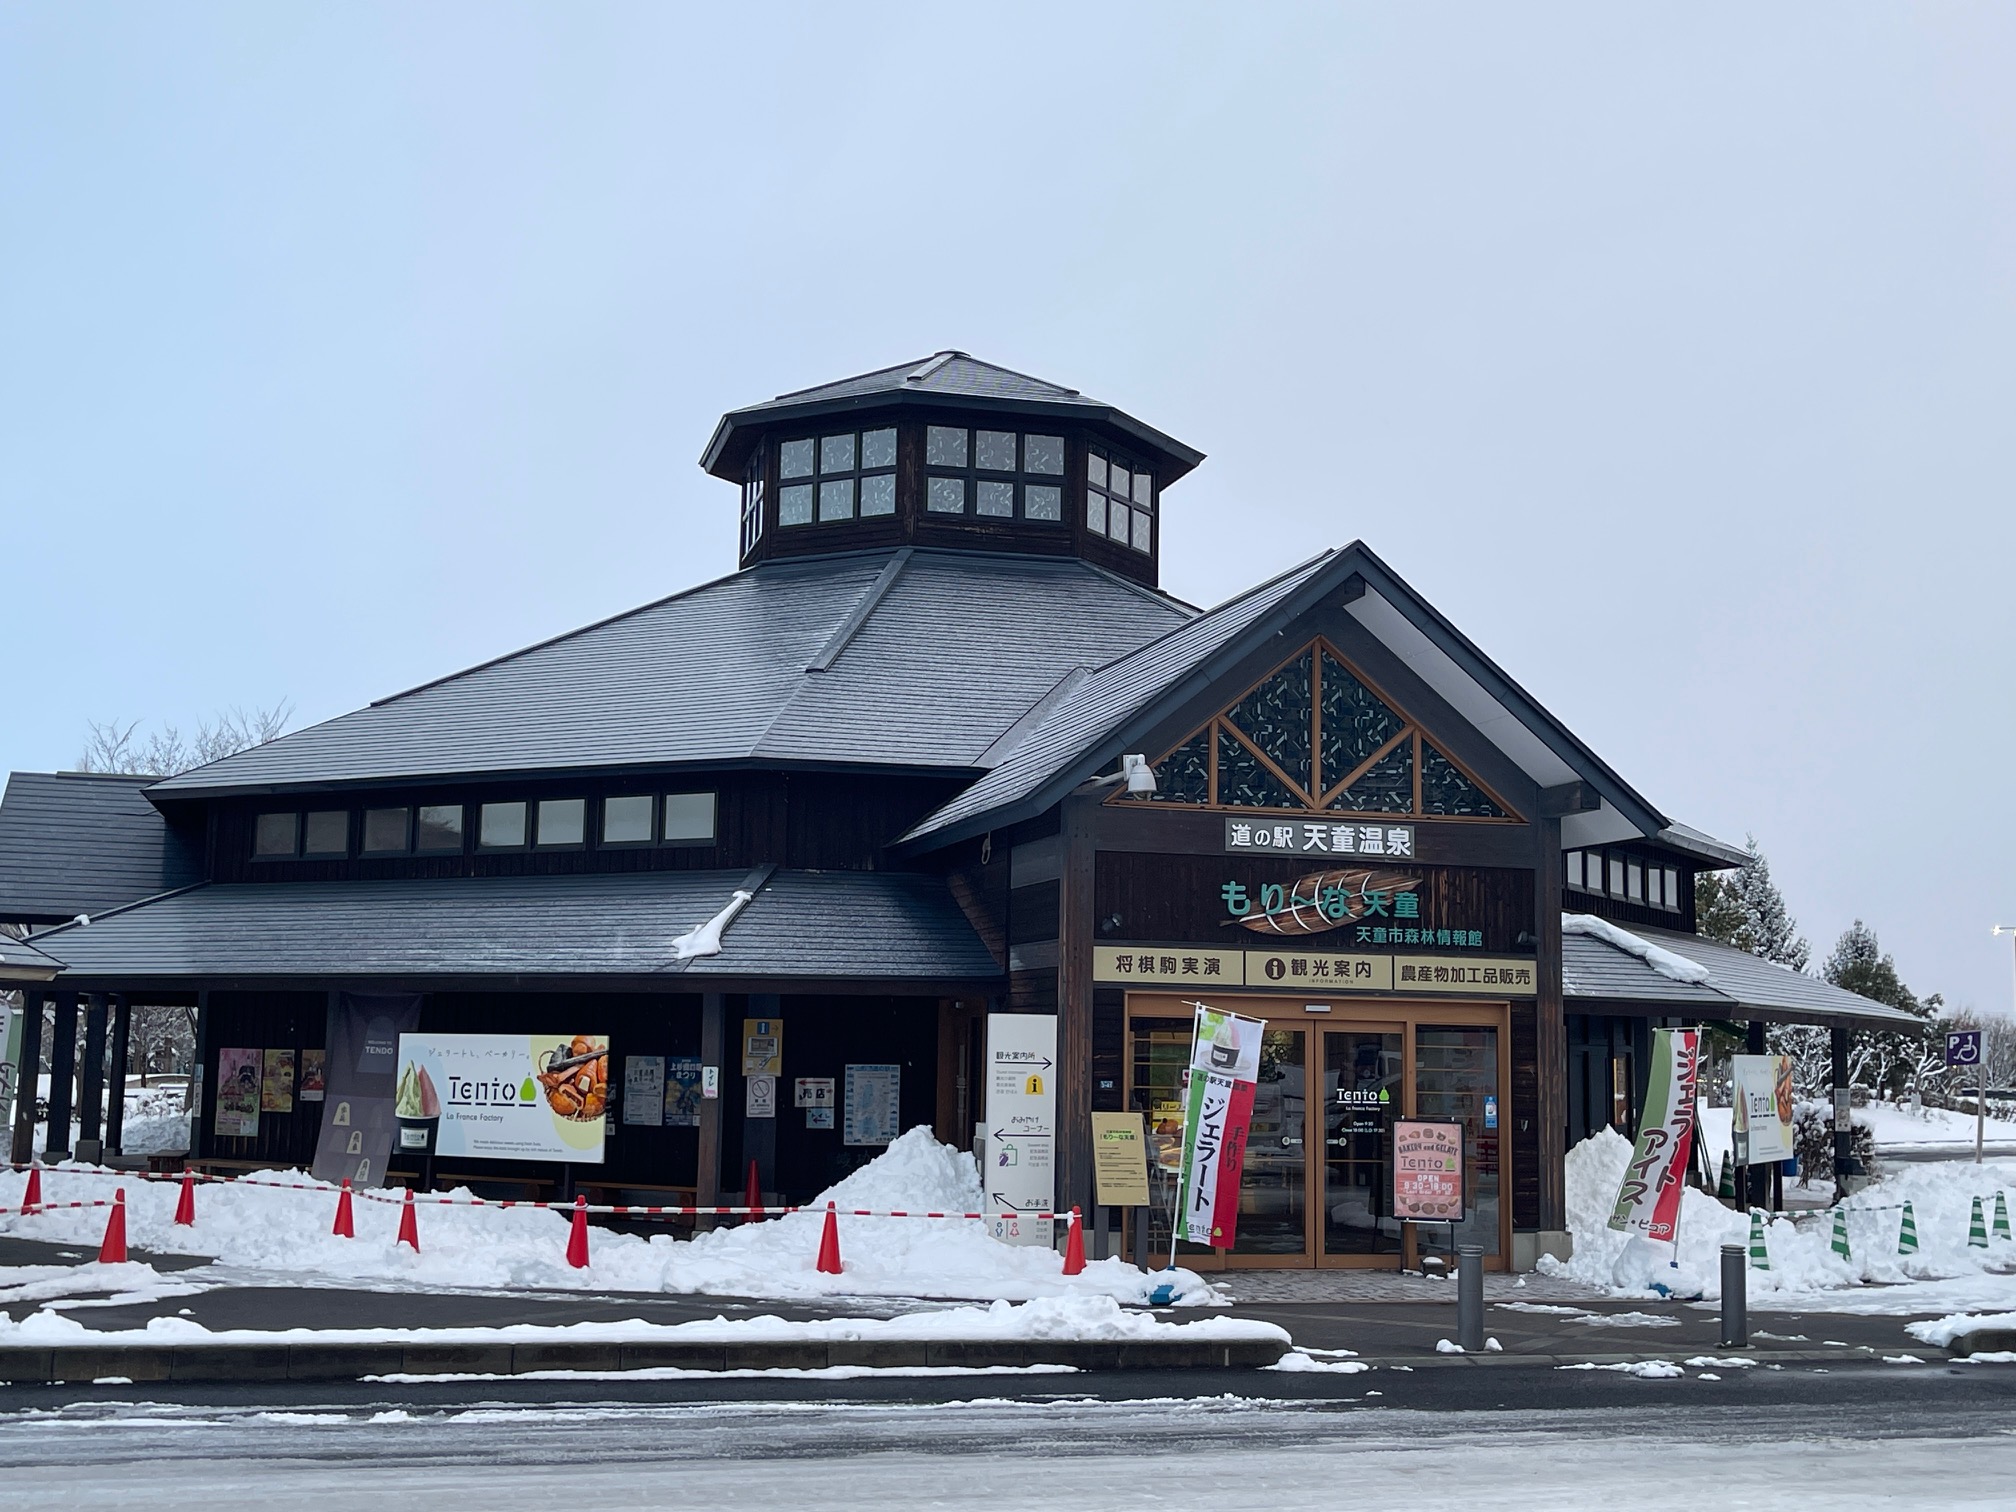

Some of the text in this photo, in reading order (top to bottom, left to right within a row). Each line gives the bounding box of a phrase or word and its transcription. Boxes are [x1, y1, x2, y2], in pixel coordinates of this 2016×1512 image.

[1231, 824, 1411, 855] 道の駅 天童温泉
[1356, 926, 1483, 947] 天童市森林情報館
[1115, 954, 1221, 976] 将棋駒実演
[1291, 958, 1371, 979] 観光案内
[1401, 964, 1531, 985] 農産物加工品販売
[1949, 1036, 1960, 1049] P
[365, 1046, 393, 1054] TENDO
[996, 1051, 1036, 1060] 観光案内所
[449, 1076, 516, 1101] Tento
[1336, 1088, 1378, 1101] Tento
[446, 1112, 504, 1124] La France Factory
[1398, 1143, 1422, 1153] BAKERY
[1400, 1156, 1443, 1168] Tento
[1622, 1128, 1668, 1206] アイス
[1417, 1174, 1440, 1182] OPEN
